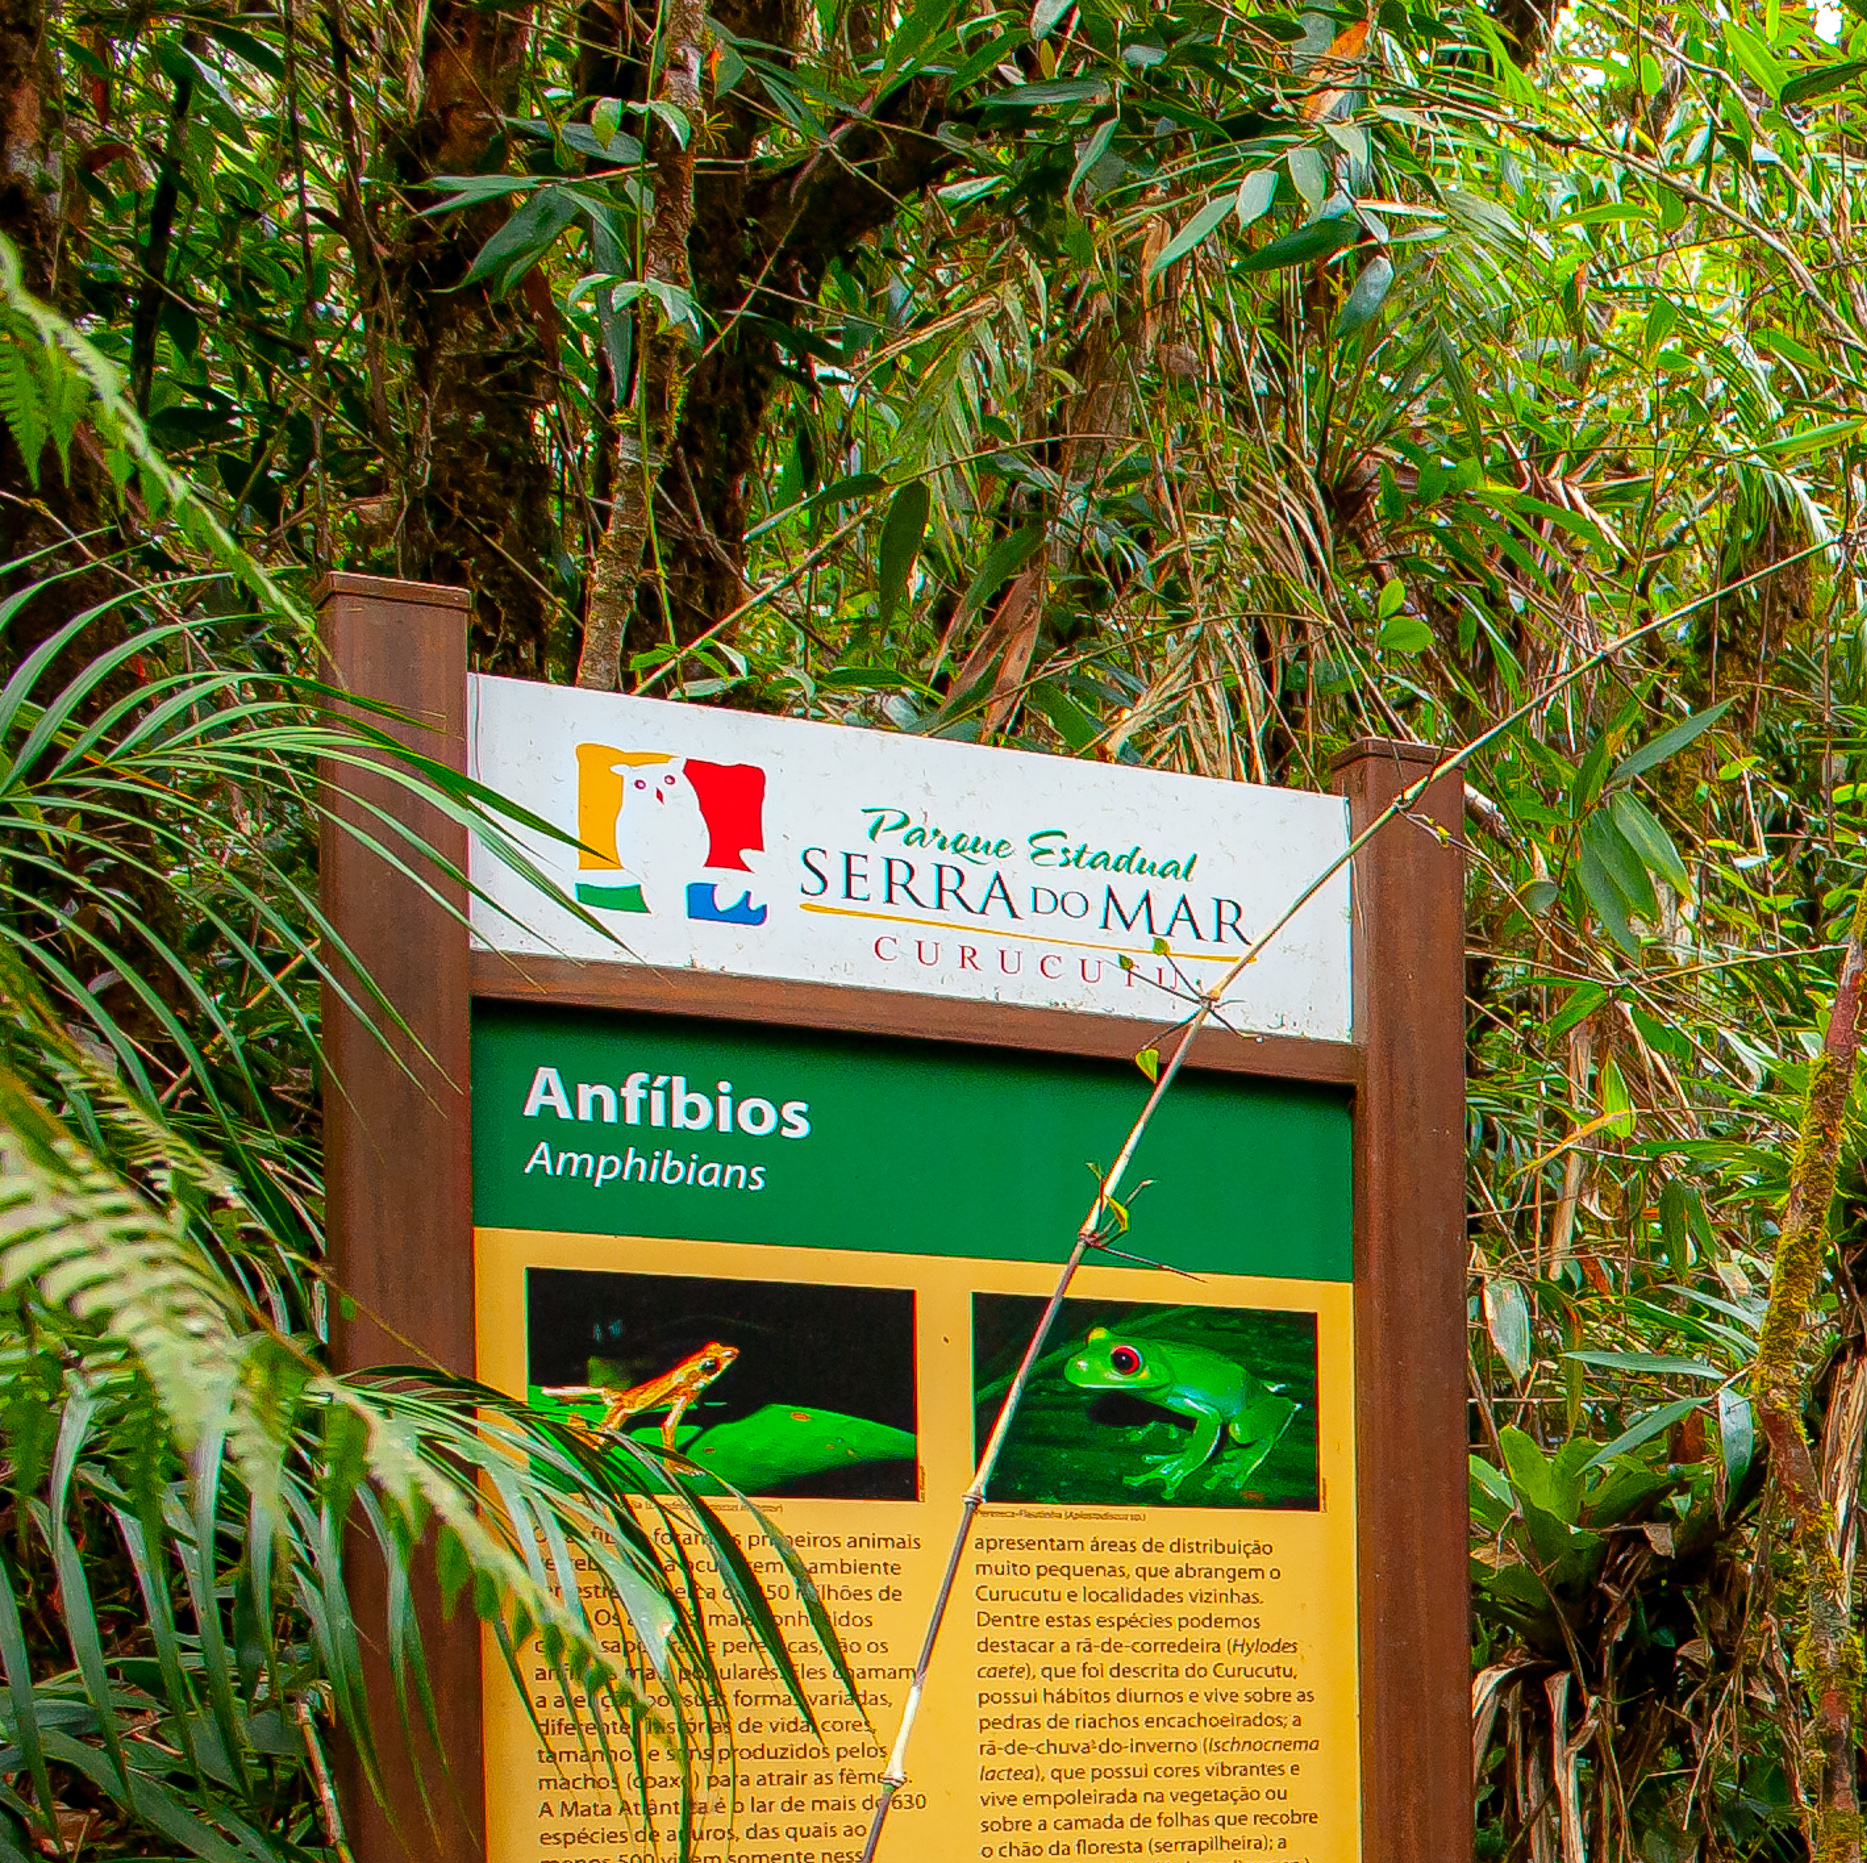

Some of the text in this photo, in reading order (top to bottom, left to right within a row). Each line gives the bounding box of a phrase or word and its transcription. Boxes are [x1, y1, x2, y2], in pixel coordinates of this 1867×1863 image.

[861, 806, 1199, 882] Parque Estadual
[799, 846, 1253, 946] SERRA DO MAR
[522, 1066, 812, 1139] Anfíbios
[522, 1141, 767, 1191] Amphibians
[845, 1532, 921, 1551] animais
[974, 1535, 1273, 1559] apresentam áreas de distribuição
[974, 1560, 1265, 1583] muito pequenas, que abrangem
[974, 1585, 1264, 1604] Curucutu localidades vizinhas.
[975, 1610, 1261, 1632] Dentre estas espécies podemos
[975, 1635, 1298, 1657] destacar rã-de-corredeira (Hylodes
[976, 1659, 1298, 1682] caete), que foi descrita do Curucutu,
[977, 1684, 1315, 1708] possui hábitos diurnos vive sobre as
[978, 1708, 1288, 1734] pedras de riachos encachoeirados;
[835, 1741, 888, 1763] pelos
[1202, 1733, 1320, 1754] (Ischnocnema
[755, 1768, 809, 1786] atrair
[979, 1757, 1285, 1783] lactea), que possui cores vibrantes
[558, 1794, 857, 1817] Mata lar mais
[979, 1782, 1288, 1808] vive empoleirada na vegetação ou
[979, 1805, 1319, 1831] sobre camada de folhas que recobre
[539, 1820, 838, 1848] espécies das quais
[997, 1830, 1273, 1856] chão da floresta (serrapilheira);
